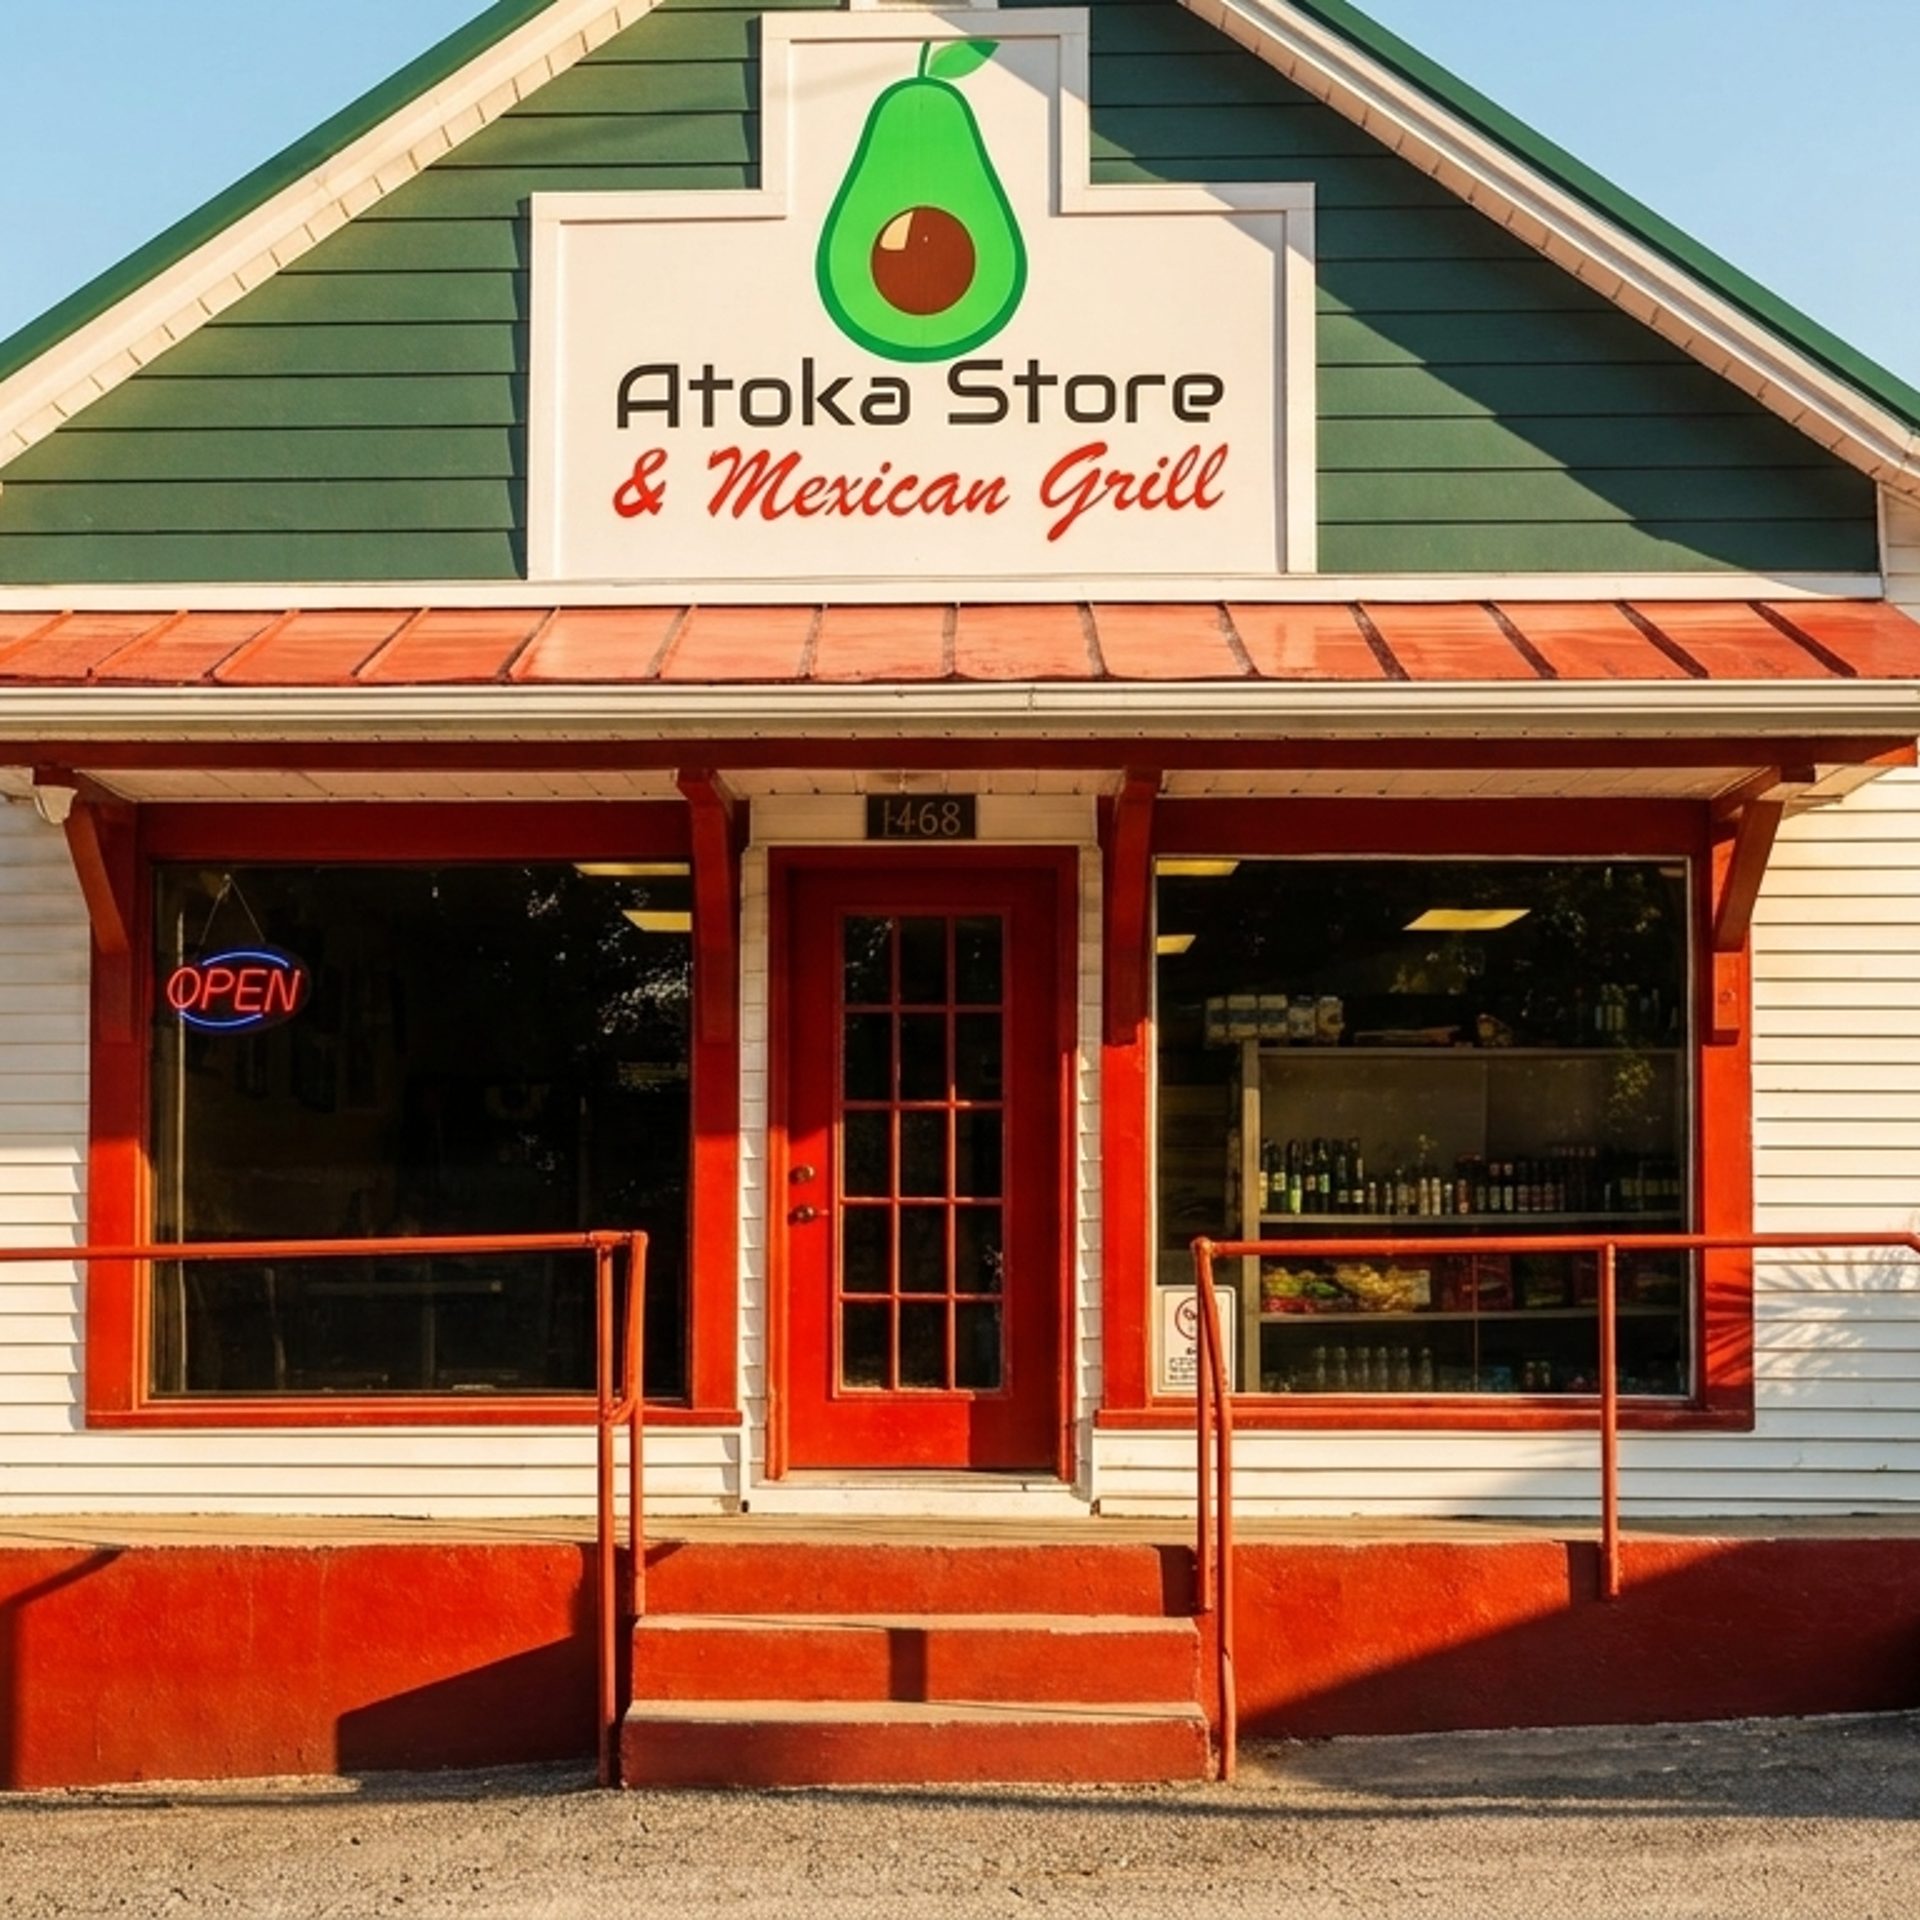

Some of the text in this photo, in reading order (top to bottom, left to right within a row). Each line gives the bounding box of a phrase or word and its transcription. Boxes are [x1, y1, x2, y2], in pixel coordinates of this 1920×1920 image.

[616, 357, 1225, 428] Atoka Store
[613, 440, 1229, 542] & Mexican Grill
[883, 799, 961, 835] 1468
[166, 966, 301, 1012] OPEN
